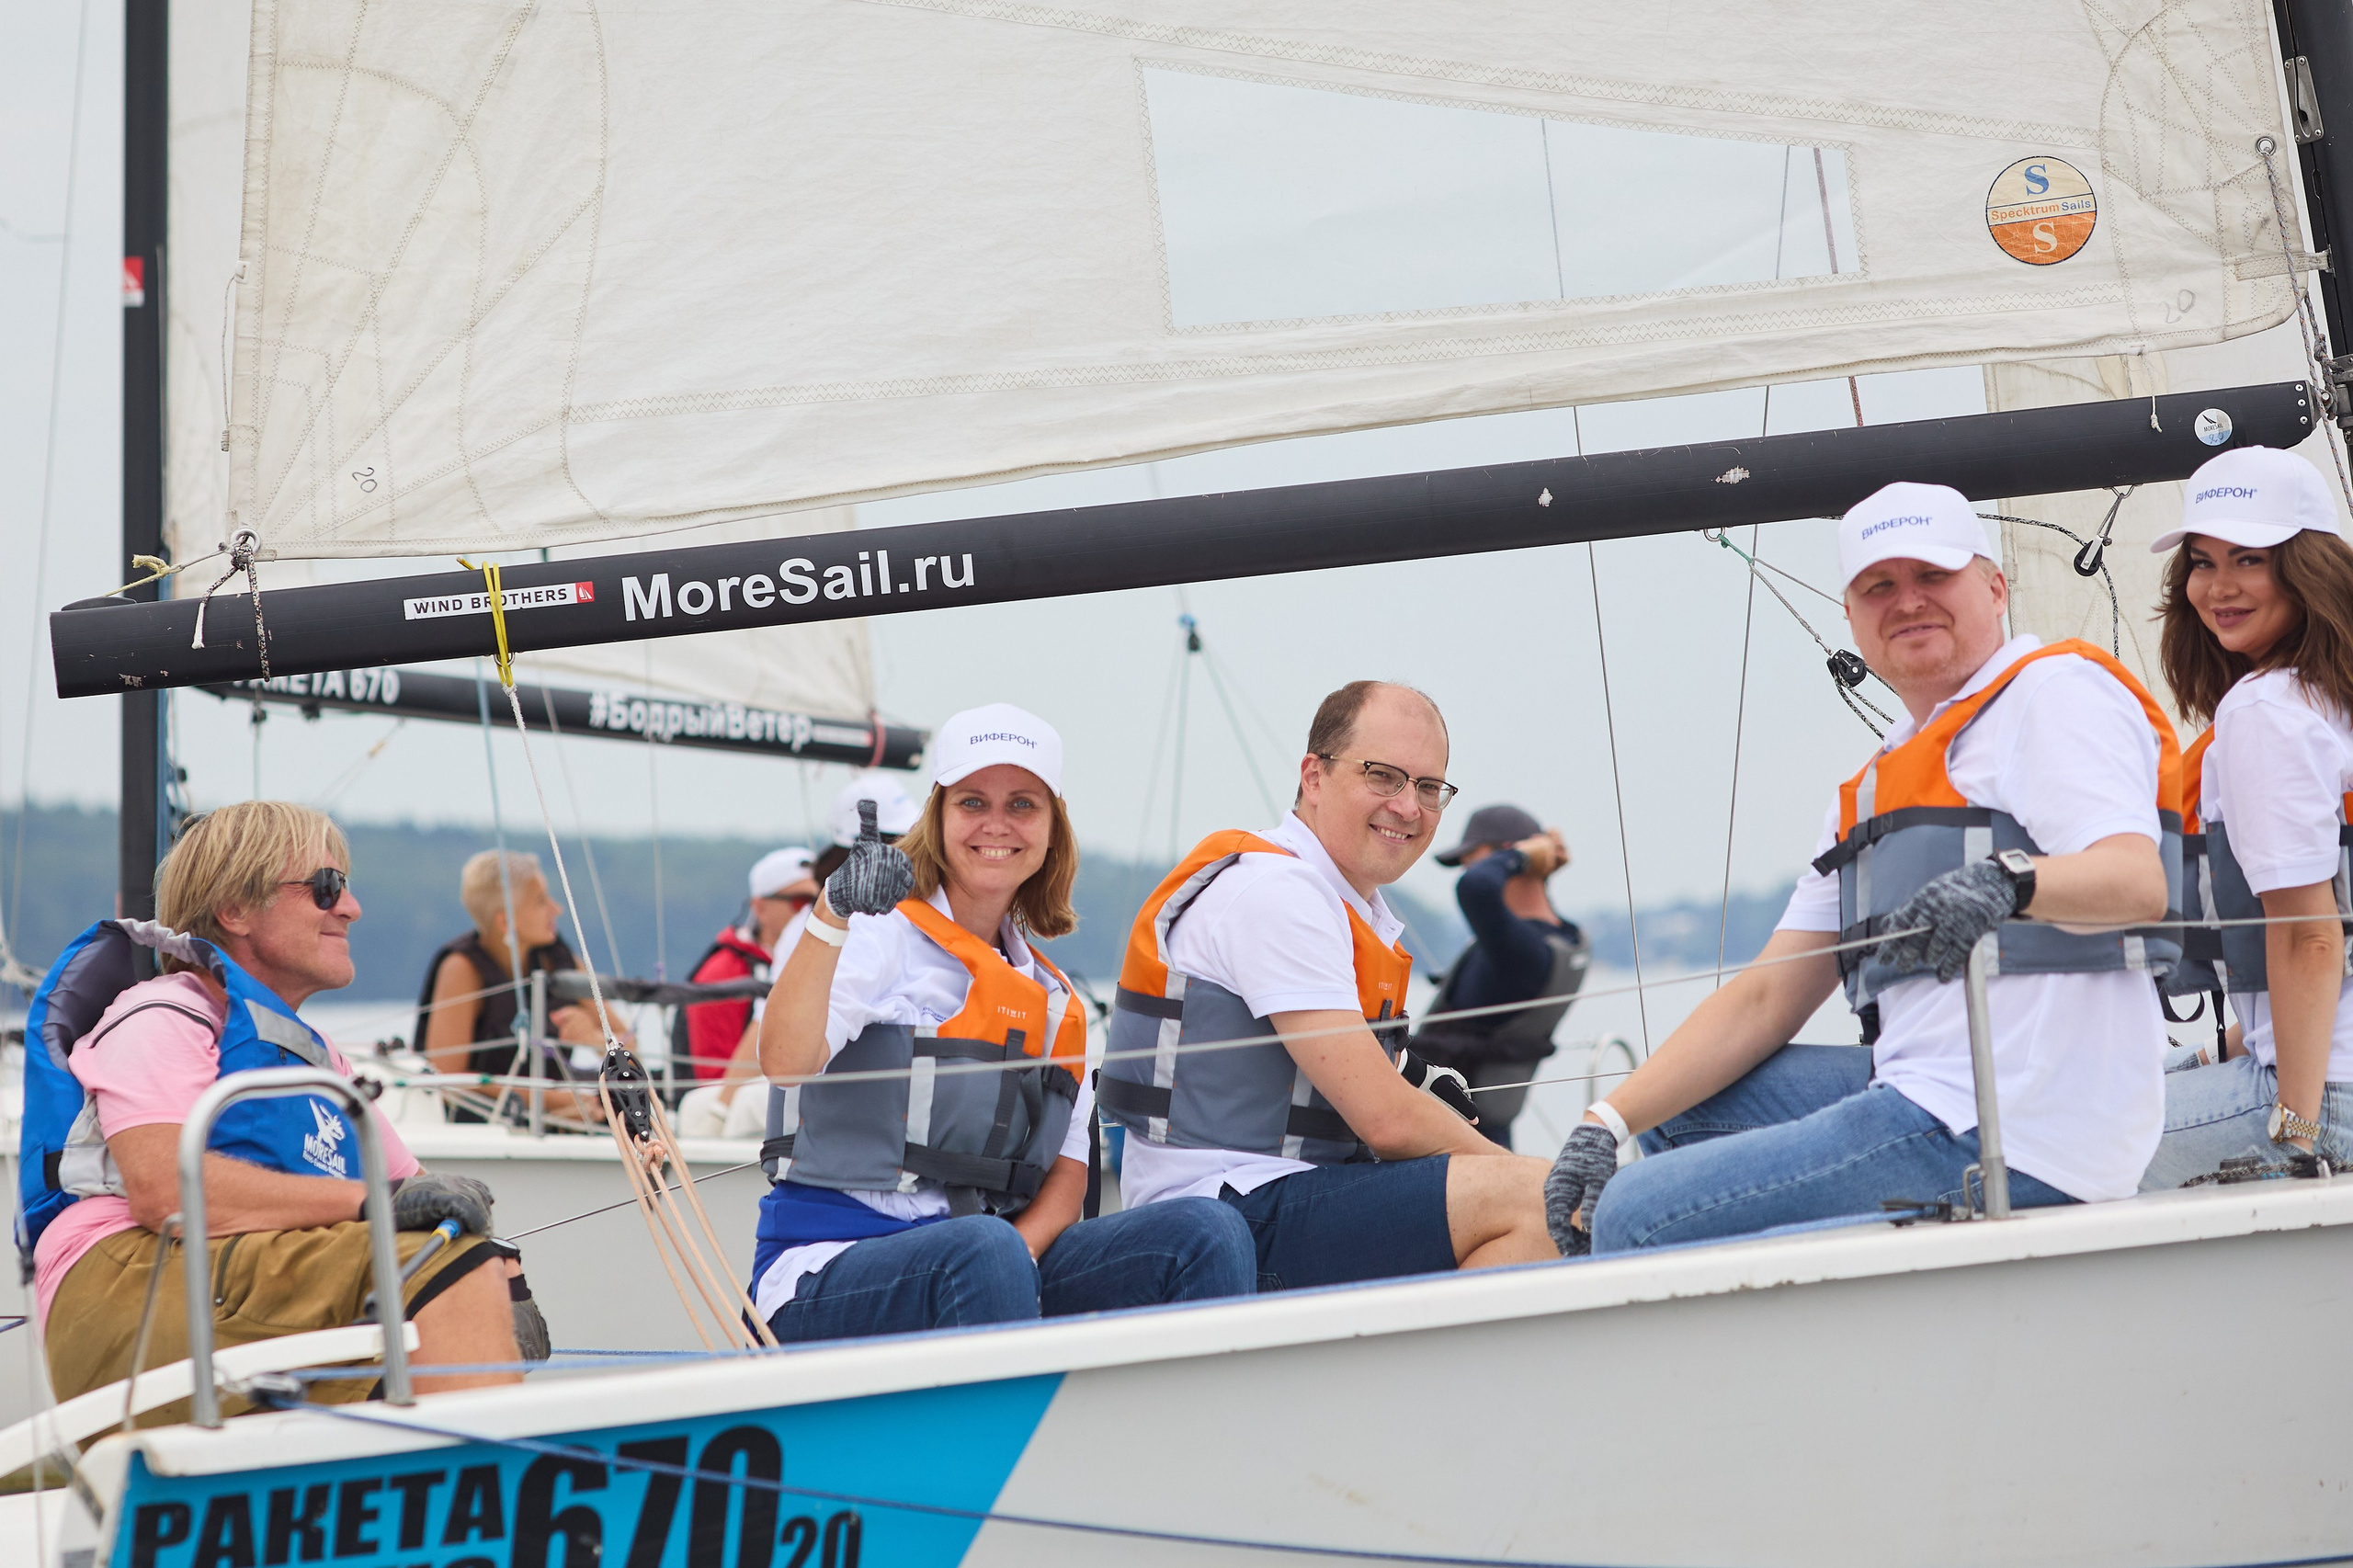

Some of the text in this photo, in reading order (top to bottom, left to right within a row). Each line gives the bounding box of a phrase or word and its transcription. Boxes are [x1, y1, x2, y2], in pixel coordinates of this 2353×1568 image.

[2024, 164, 2050, 196] S
[1991, 199, 2091, 222] Specktrum Sails
[2032, 222, 2058, 254] S
[351, 466, 378, 494] 20
[621, 550, 975, 622] MoreSail.ru
[414, 598, 463, 614] WIND
[349, 666, 401, 705] 670
[997, 1006, 1027, 1019] ITIWIT
[303, 1132, 347, 1175] MORESAIL
[130, 1426, 862, 1568] РАКЕТА 670 20
